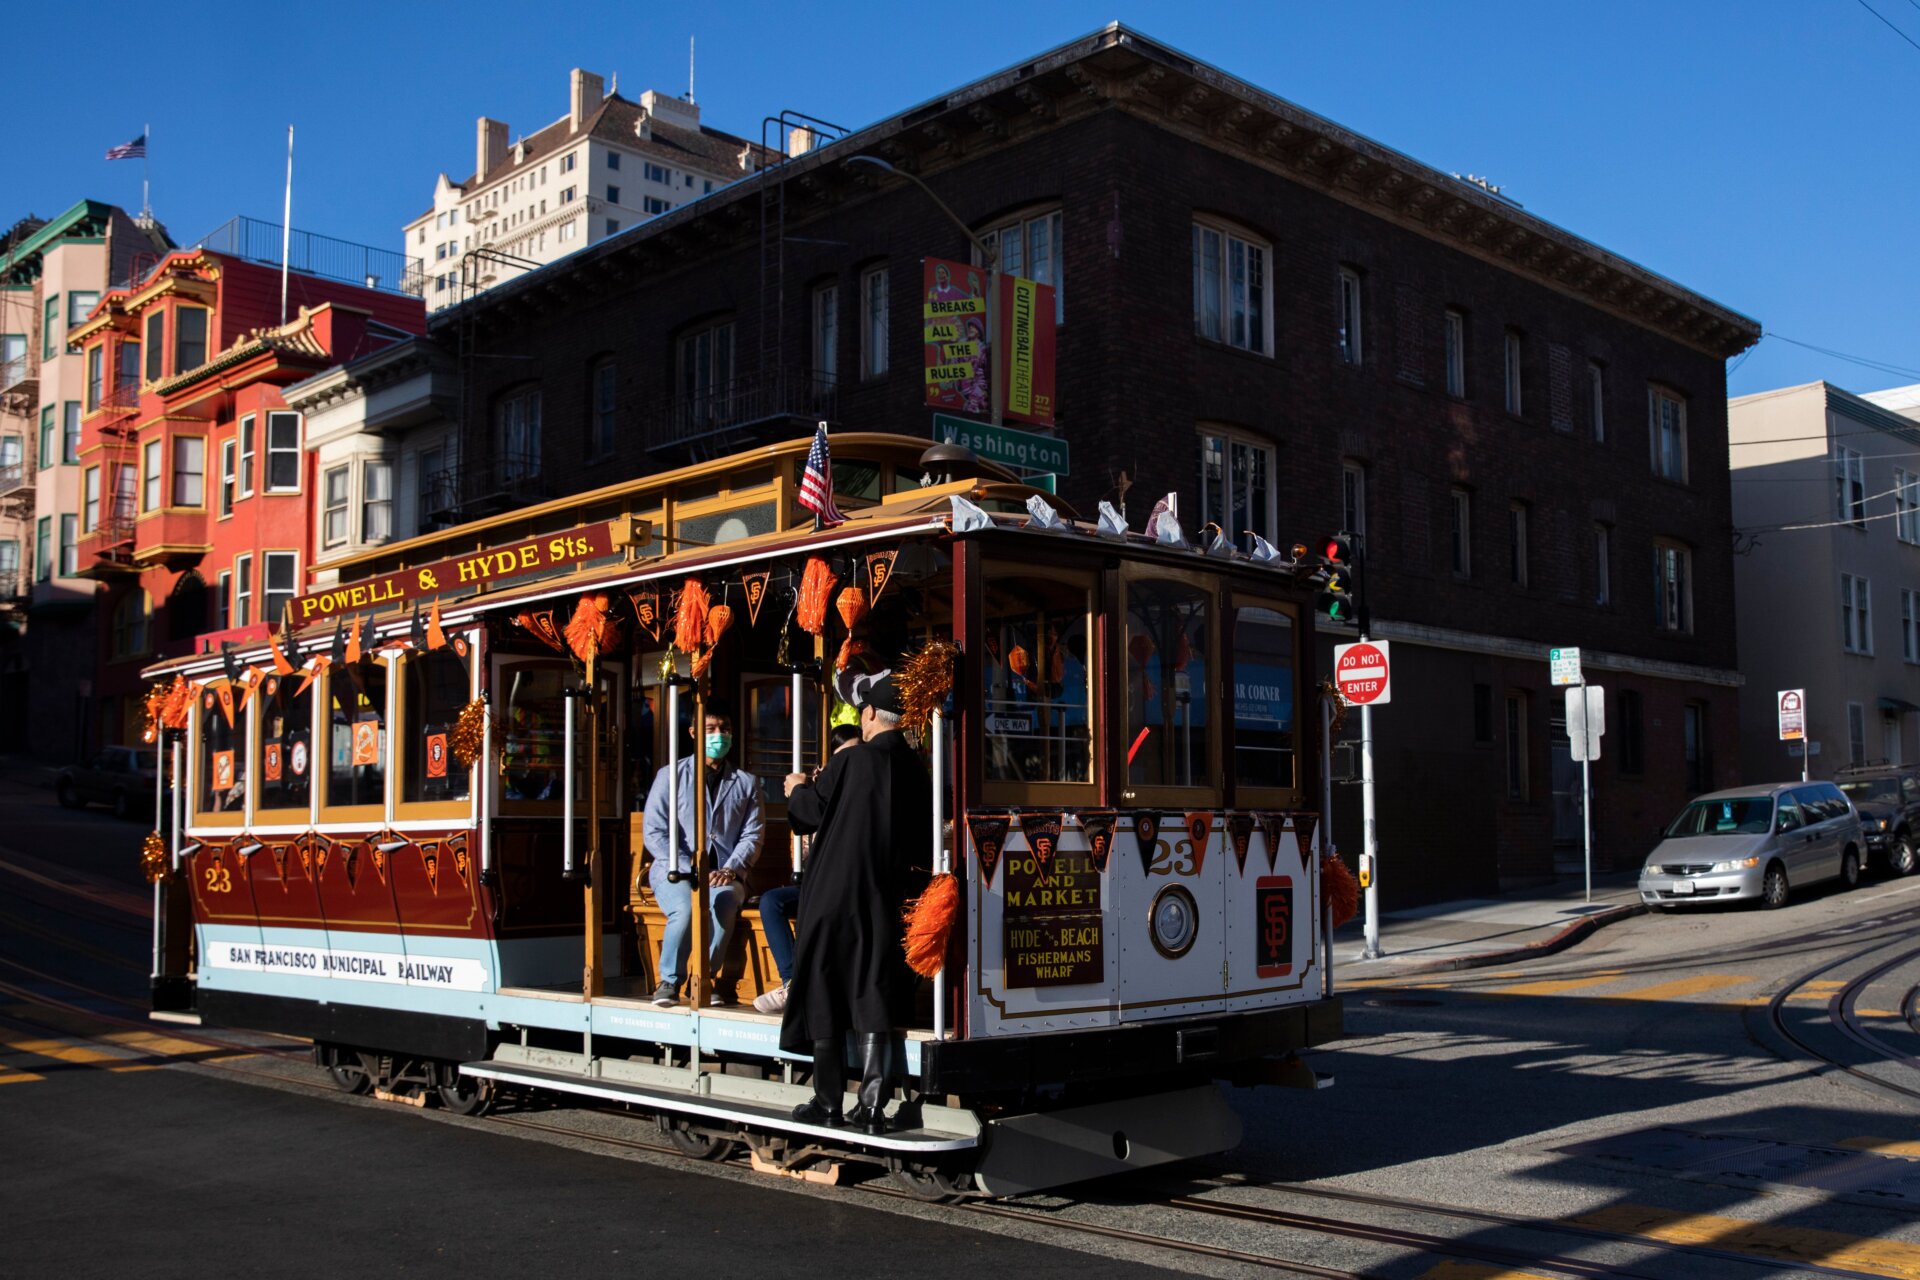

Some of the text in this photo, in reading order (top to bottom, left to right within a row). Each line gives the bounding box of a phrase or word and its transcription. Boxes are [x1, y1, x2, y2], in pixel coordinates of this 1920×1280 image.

[931, 301, 976, 313] BREAKS
[932, 326, 953, 337] ALL
[949, 345, 971, 356] THE
[930, 367, 966, 379] RULES
[943, 424, 1061, 465] Washington
[301, 536, 595, 618] POWELL & HYDE Sts.
[1343, 654, 1380, 667] DO NOT
[1234, 683, 1280, 701] AR CORNER
[1347, 681, 1378, 693] ENTER
[995, 719, 1027, 729] ONE WAY
[1150, 839, 1198, 877] 23
[1009, 858, 1096, 876] POELL
[205, 868, 232, 893] 23
[1033, 875, 1075, 888] AND
[1007, 889, 1097, 907] MARKET
[1010, 929, 1041, 948] HYDE
[1061, 927, 1099, 946] BEACH
[230, 948, 250, 964] SAN
[255, 950, 317, 969] FRANCISCO
[1018, 950, 1092, 966] FISHERMANS
[1035, 965, 1074, 979] WHARF
